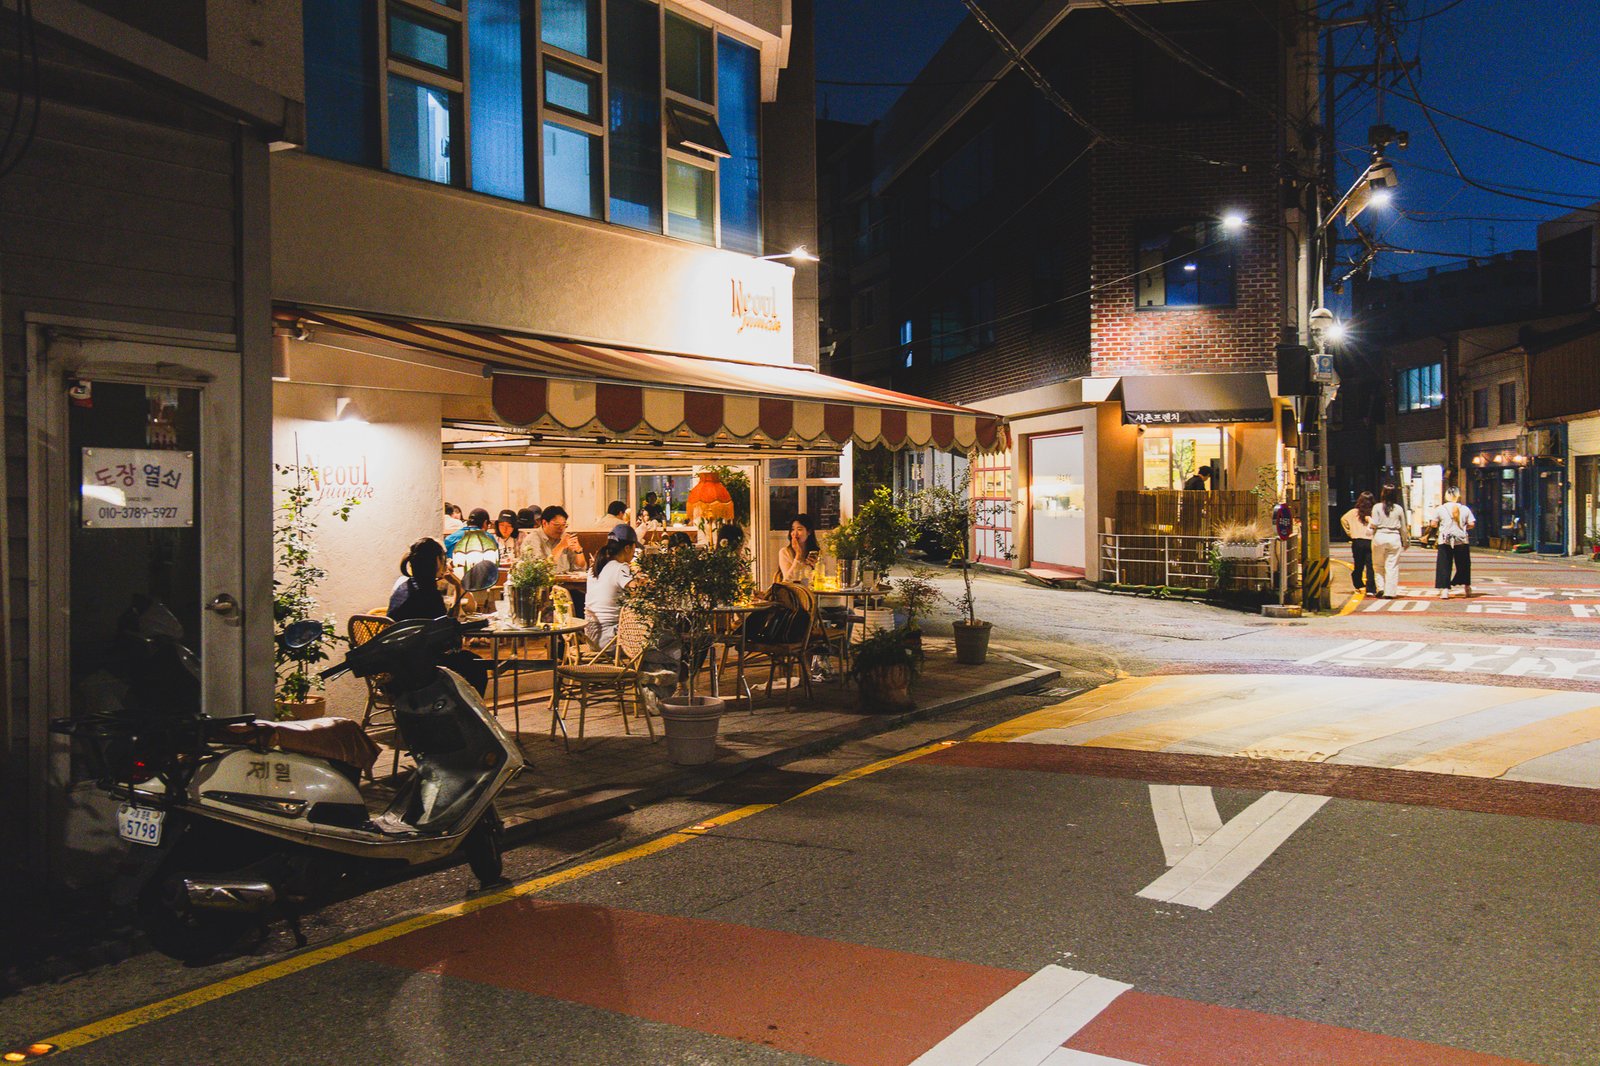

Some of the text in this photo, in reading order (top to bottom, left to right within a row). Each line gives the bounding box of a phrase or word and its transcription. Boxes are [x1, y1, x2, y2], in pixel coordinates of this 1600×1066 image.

[1135, 412, 1181, 423] 서촌프렌치
[95, 463, 182, 490] 도장 열쇠
[98, 507, 179, 519] 010-3789-5927
[246, 760, 292, 784] 제일
[126, 820, 157, 840] 5798
